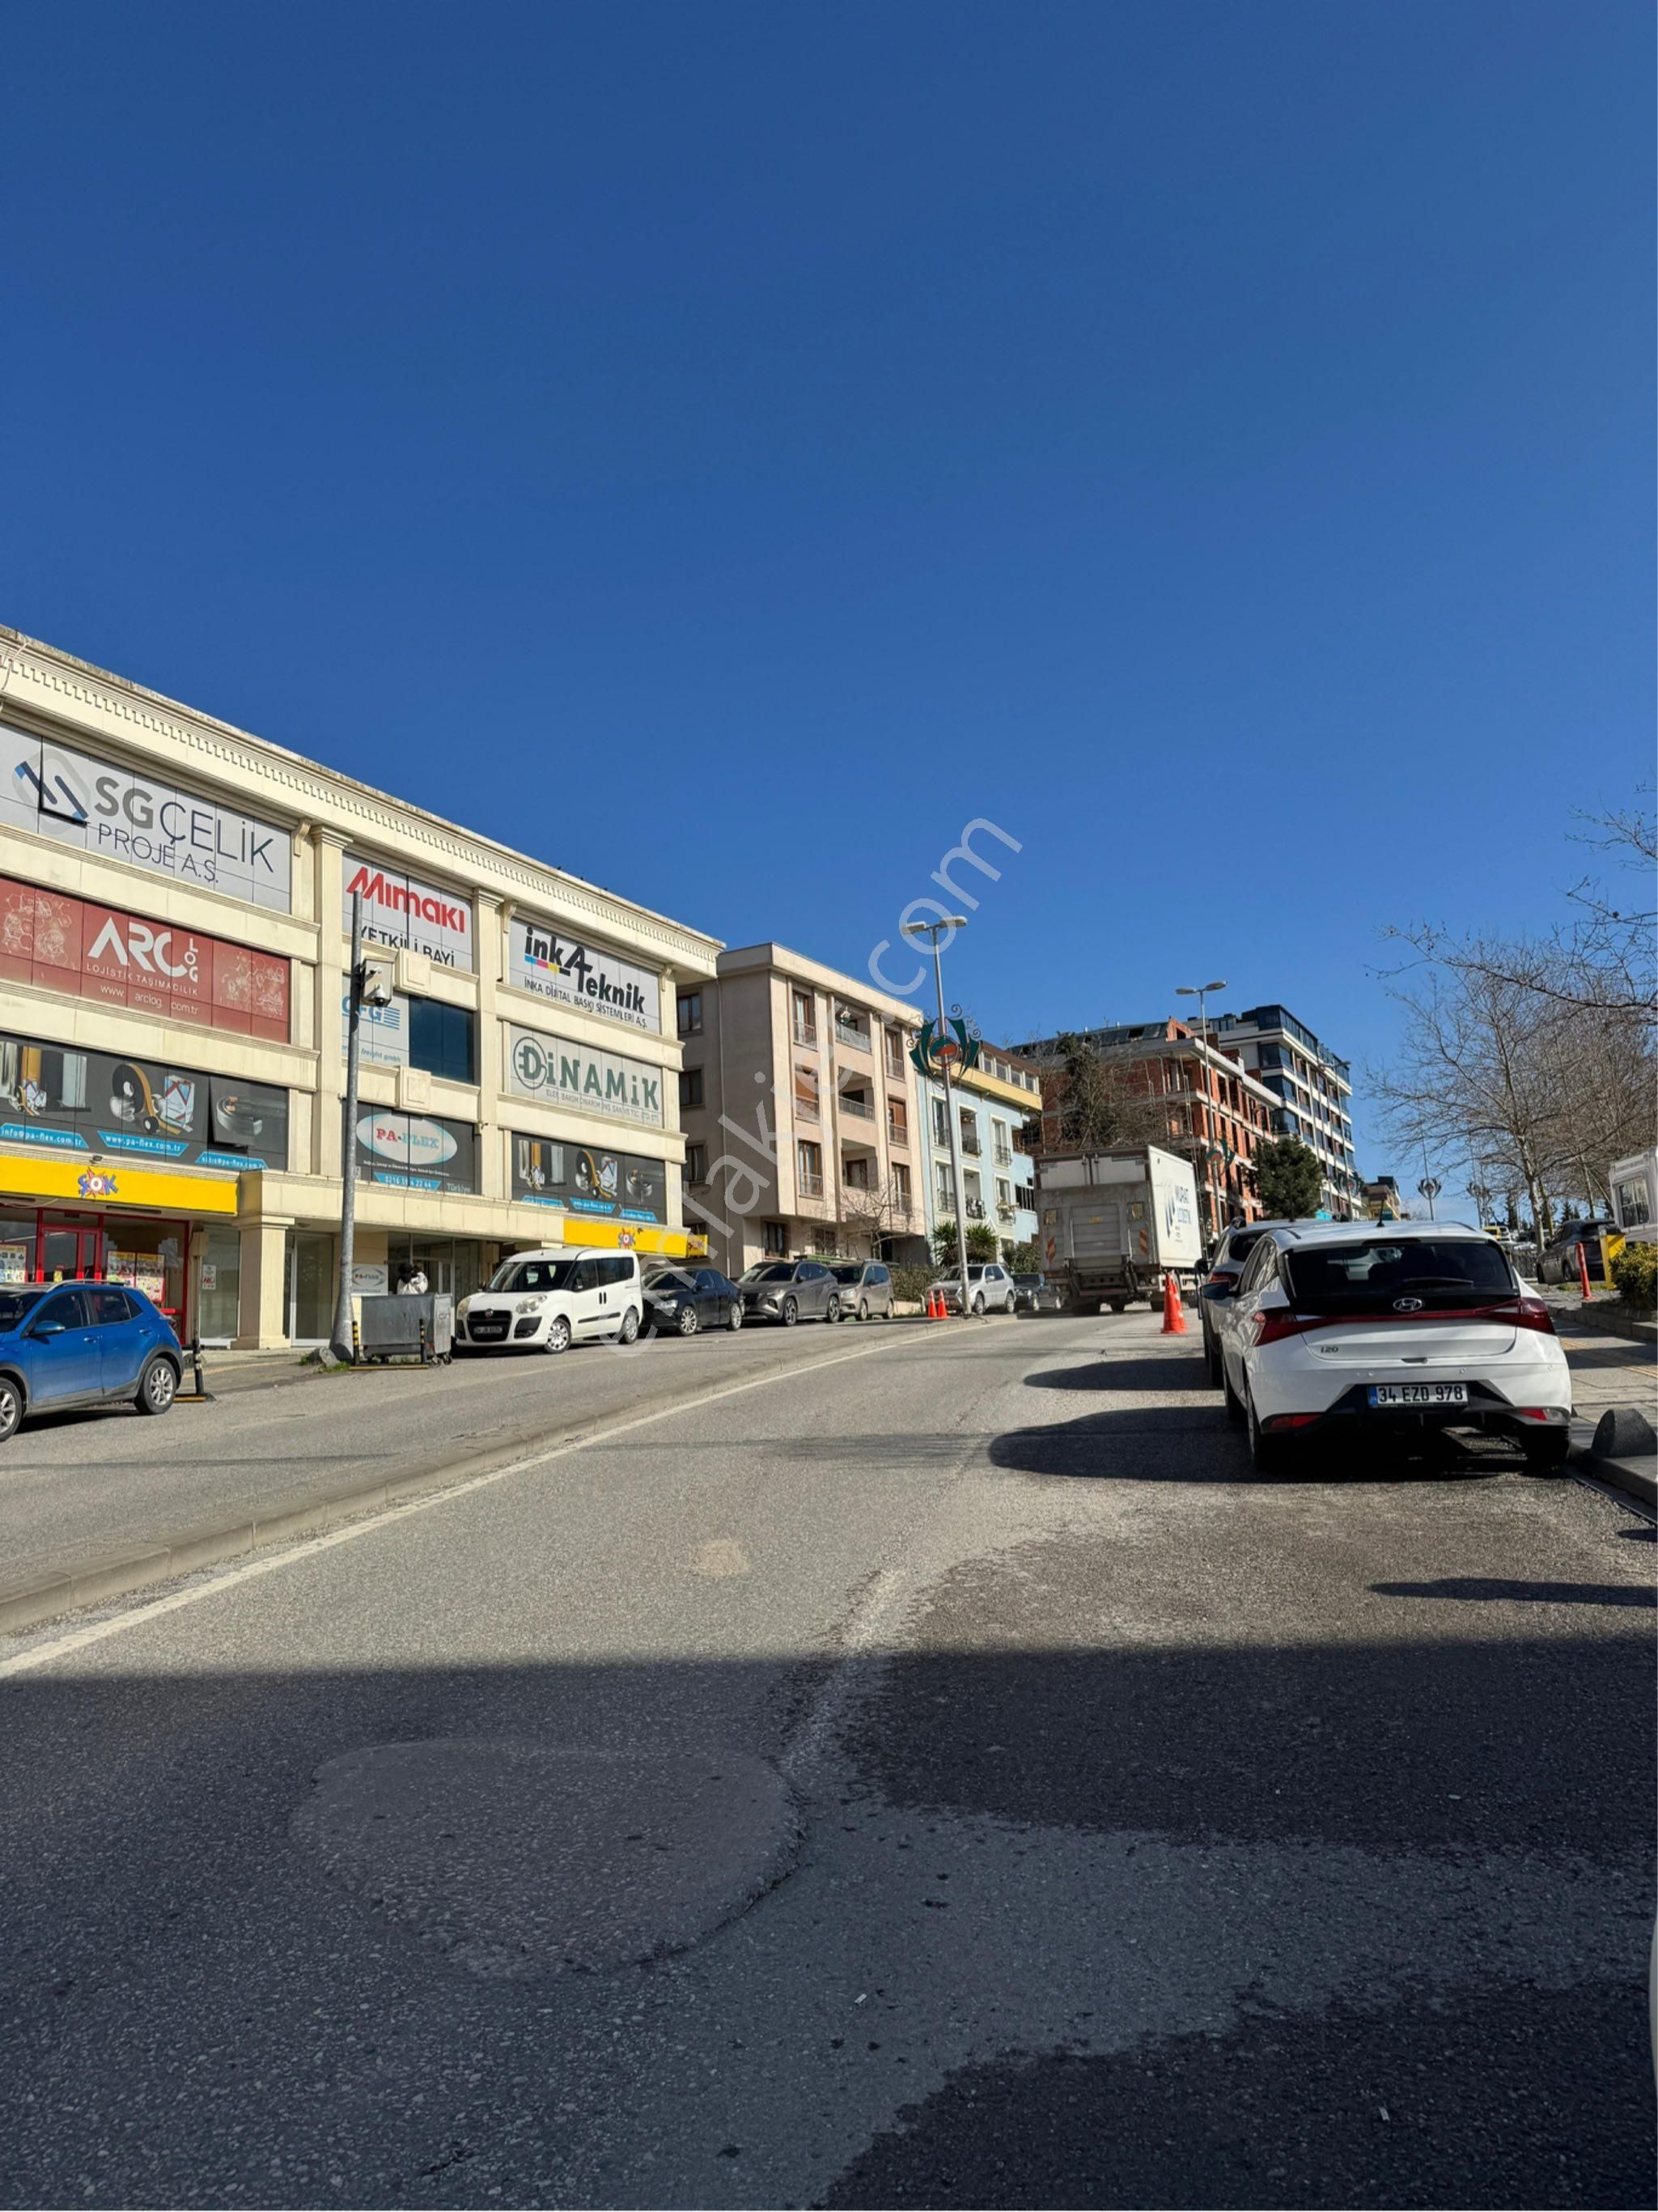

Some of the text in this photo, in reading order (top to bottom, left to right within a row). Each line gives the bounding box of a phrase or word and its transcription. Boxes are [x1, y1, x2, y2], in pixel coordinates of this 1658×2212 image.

[94, 776, 154, 830] SG
[98, 822, 176, 869] PROJE
[87, 916, 189, 978] ARC
[135, 973, 198, 996] TAŞIMACILIK
[1379, 1385, 1463, 1403] 34 EZD 978
